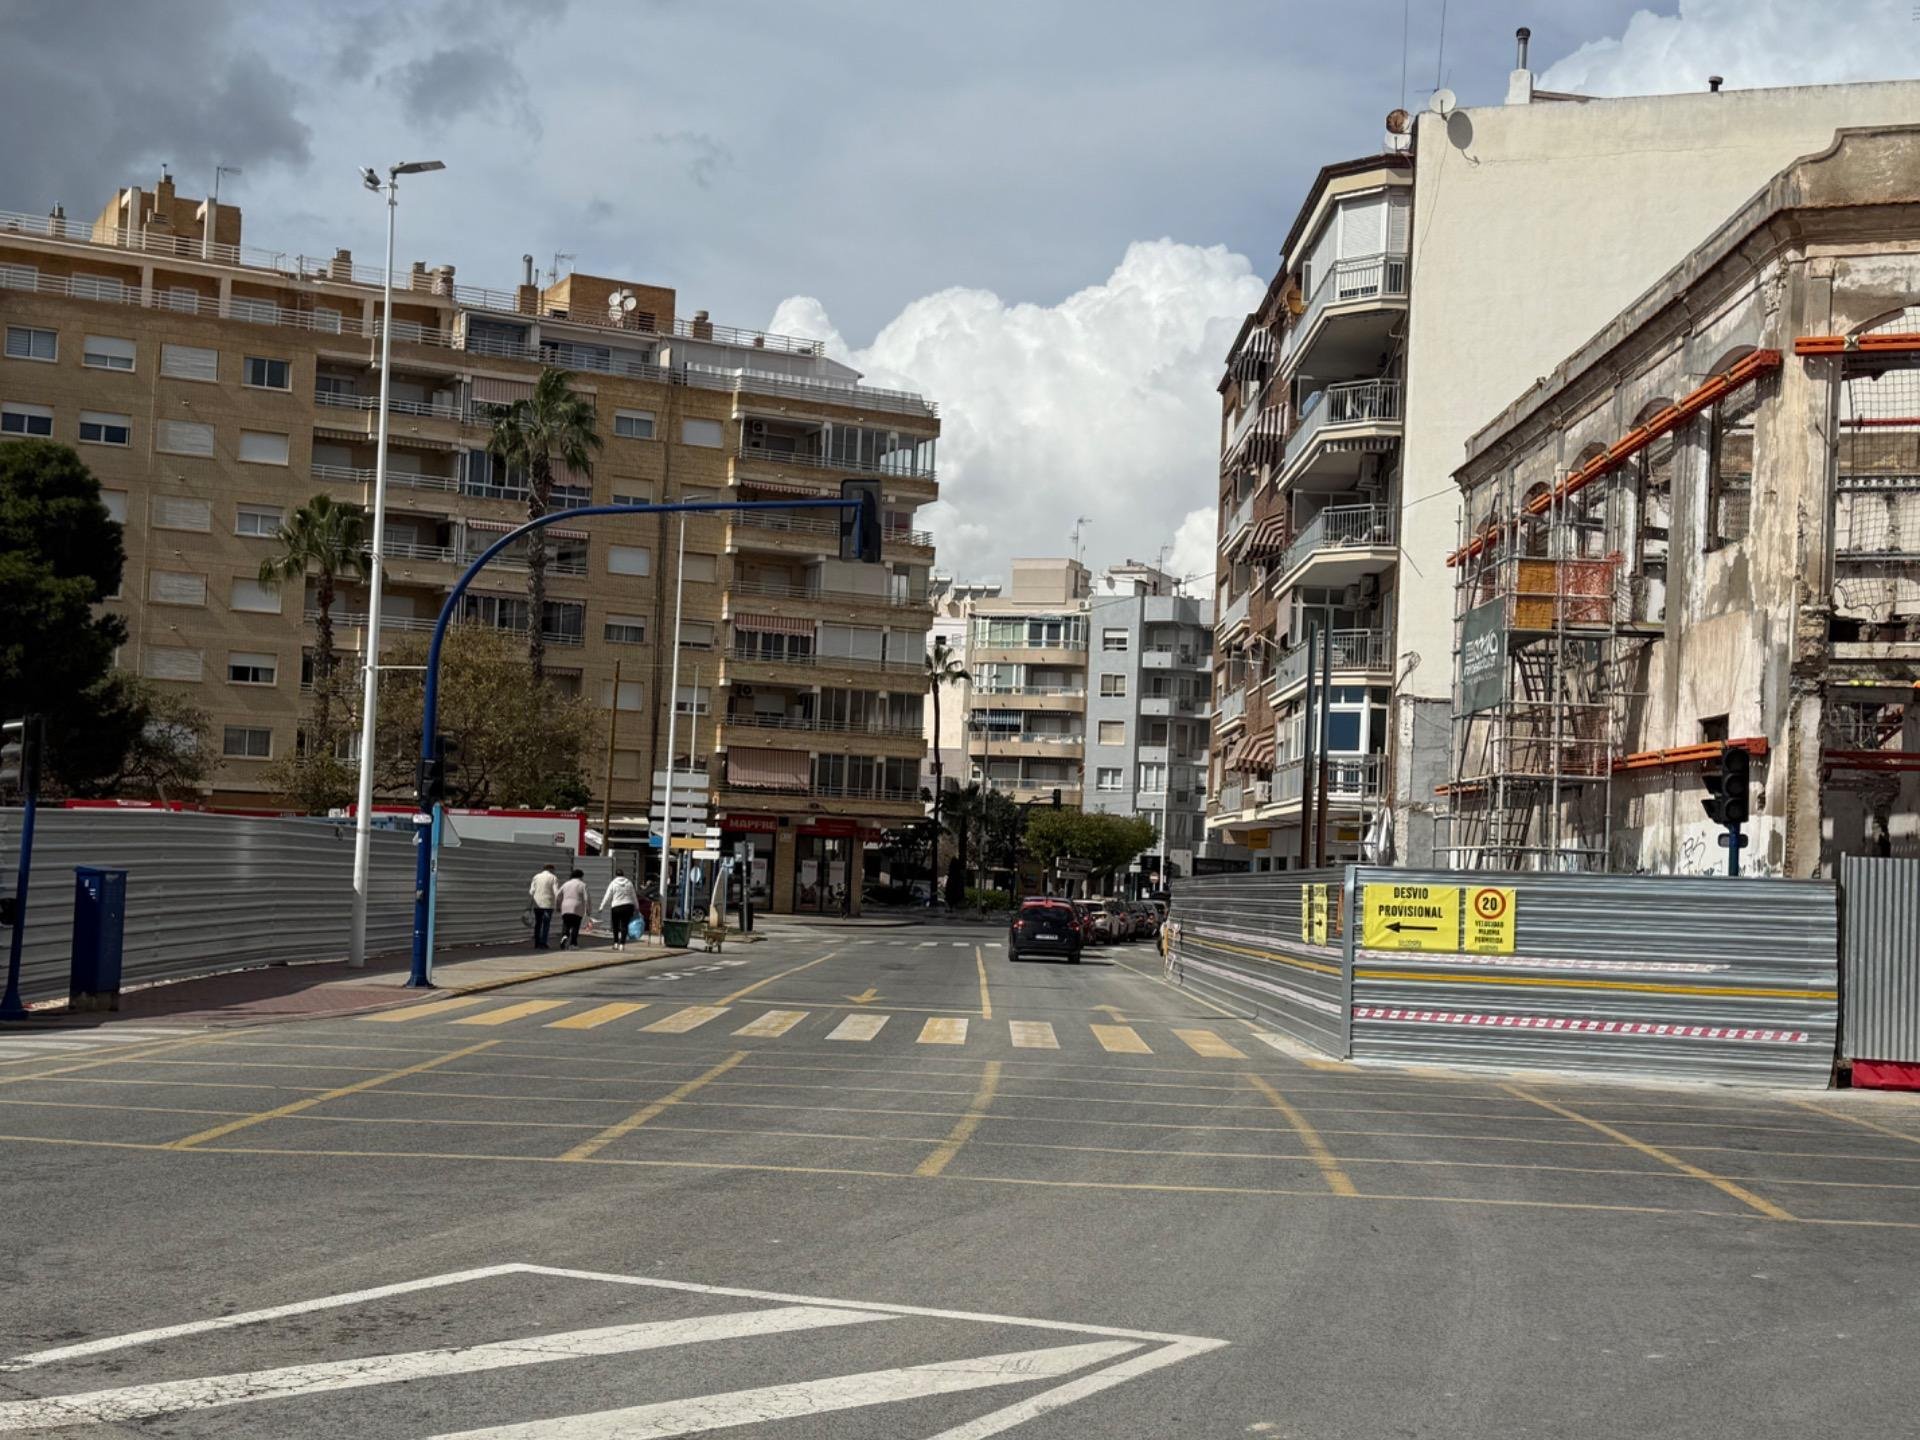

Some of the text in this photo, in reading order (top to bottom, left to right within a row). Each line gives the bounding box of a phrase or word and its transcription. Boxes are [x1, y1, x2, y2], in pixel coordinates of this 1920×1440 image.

[729, 817, 777, 830] MAPFRE
[1393, 886, 1429, 900] DESVIO
[1378, 904, 1443, 918] PROVISIONAL
[1482, 897, 1498, 911] 20
